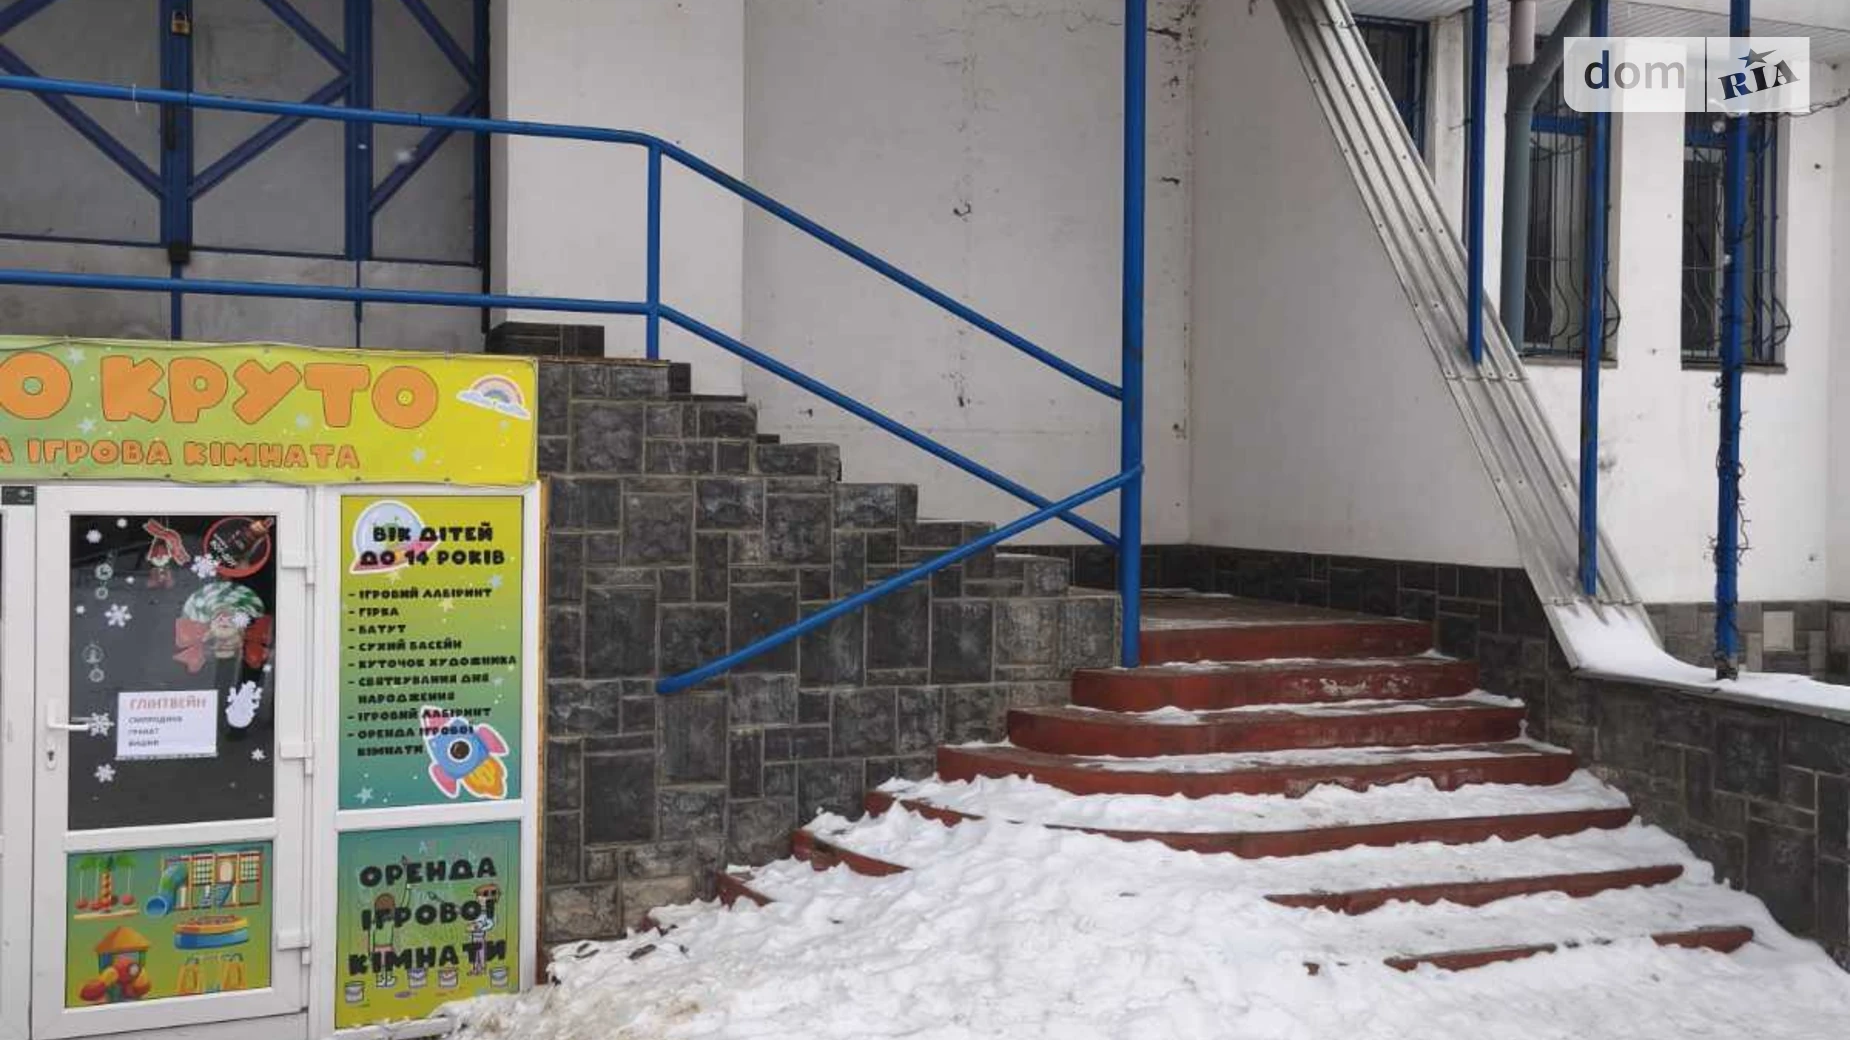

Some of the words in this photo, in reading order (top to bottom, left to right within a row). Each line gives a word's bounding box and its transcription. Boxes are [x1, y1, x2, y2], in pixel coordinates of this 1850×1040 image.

[101, 355, 439, 429] КРУТО
[27, 439, 171, 466] ІГРОВА
[183, 441, 360, 470] КІМНАТА
[373, 527, 411, 542] ВІК
[419, 521, 493, 542] ДІТЕЙ
[360, 551, 395, 566] ДО
[406, 551, 429, 565] 14
[437, 551, 505, 565] РОКІВ
[359, 587, 419, 600] ІГРОВИЙ
[423, 588, 493, 599] ЛАБІРИНТ
[359, 608, 399, 617] ГІРКА
[359, 625, 406, 635] БАТУТ
[359, 639, 407, 651] СУХИЙ
[410, 638, 462, 651] БАСЕЙН
[358, 659, 425, 669] КУТОЧОК
[429, 656, 517, 667] ХУДОЖНИКА
[358, 708, 419, 722] ІГРОВИЙ
[358, 729, 417, 740] ОРЕНДА
[357, 744, 424, 757] КІМНАТИ
[360, 857, 497, 887] ОРЕНДА
[348, 939, 507, 976] КІМНАТИ
